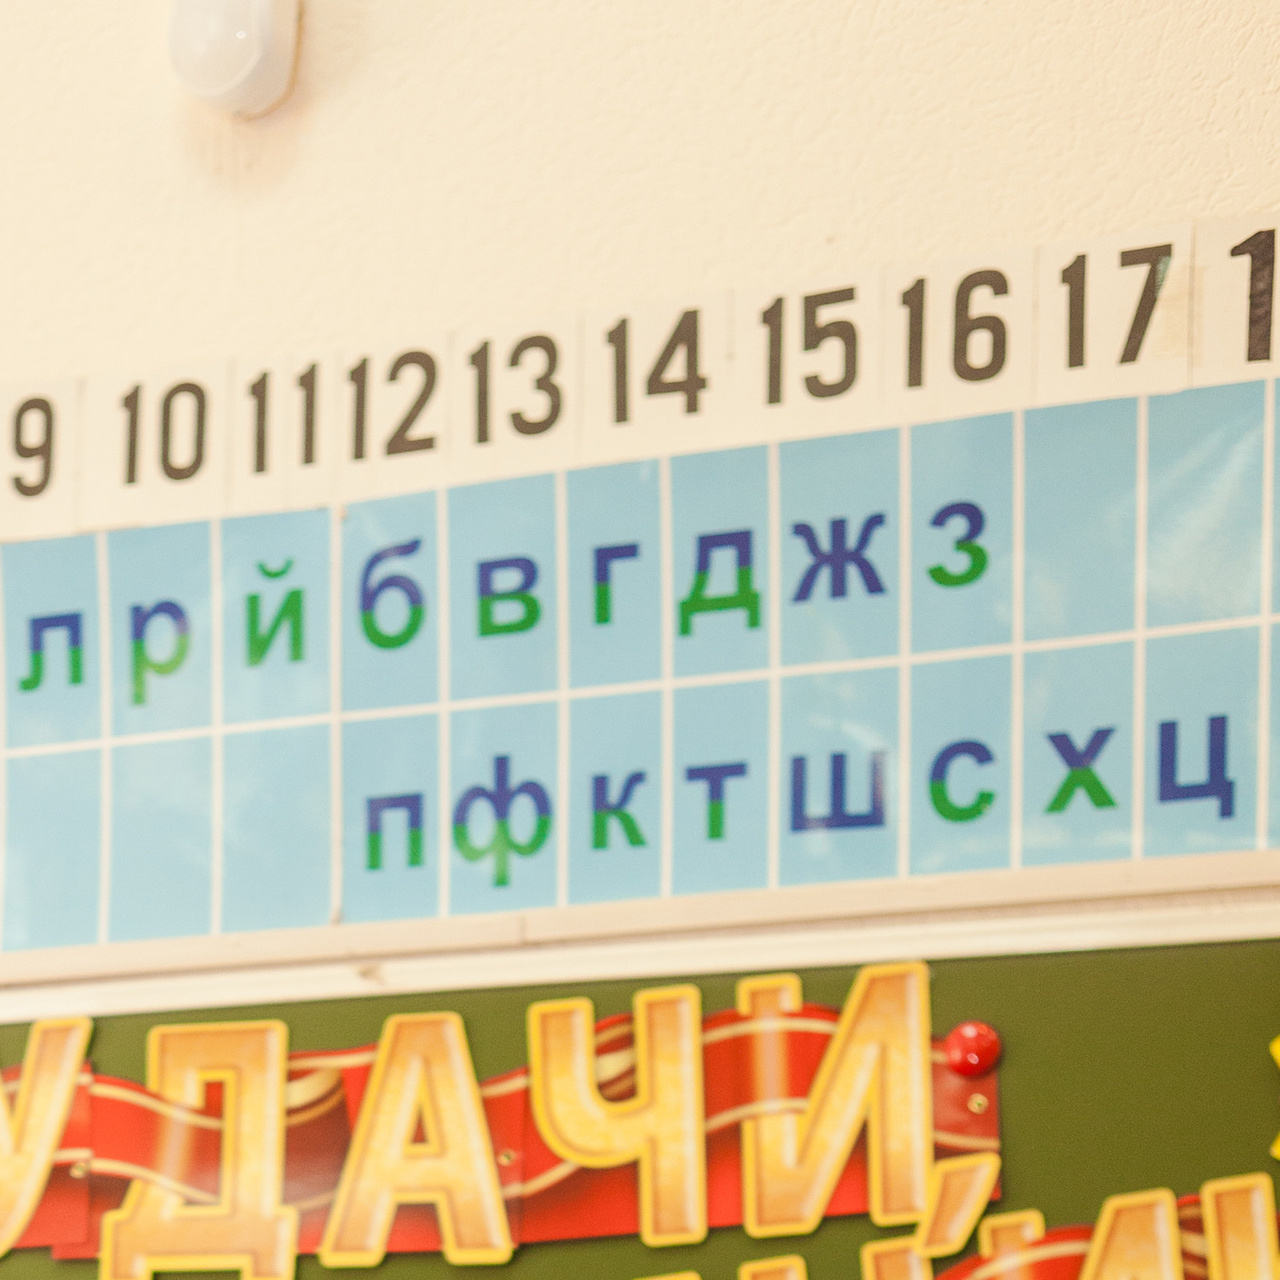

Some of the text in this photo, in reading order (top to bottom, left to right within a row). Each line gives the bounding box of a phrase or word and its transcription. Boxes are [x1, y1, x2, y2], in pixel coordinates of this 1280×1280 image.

[10, 396, 56, 499] 9
[120, 380, 209, 486] 10
[247, 362, 319, 475] 11
[347, 349, 439, 462] 12
[467, 333, 564, 446] 13
[605, 308, 710, 425] 14
[759, 285, 860, 406] 15
[899, 267, 1011, 390] 16
[1059, 241, 1174, 370] 17
[1228, 227, 1280, 364] 1
[16, 609, 87, 695] л
[126, 597, 192, 706] р
[243, 557, 307, 668] й
[357, 535, 429, 653] б
[473, 553, 546, 641] в
[589, 539, 644, 630] г
[674, 525, 765, 640] д
[787, 508, 891, 607] ж
[363, 790, 427, 874] п
[450, 752, 556, 890] ф
[588, 768, 650, 853] к
[682, 759, 751, 844] т
[787, 749, 888, 836] ш
[925, 736, 999, 827] с
[1041, 724, 1120, 817] х
[1154, 711, 1240, 823] ц
